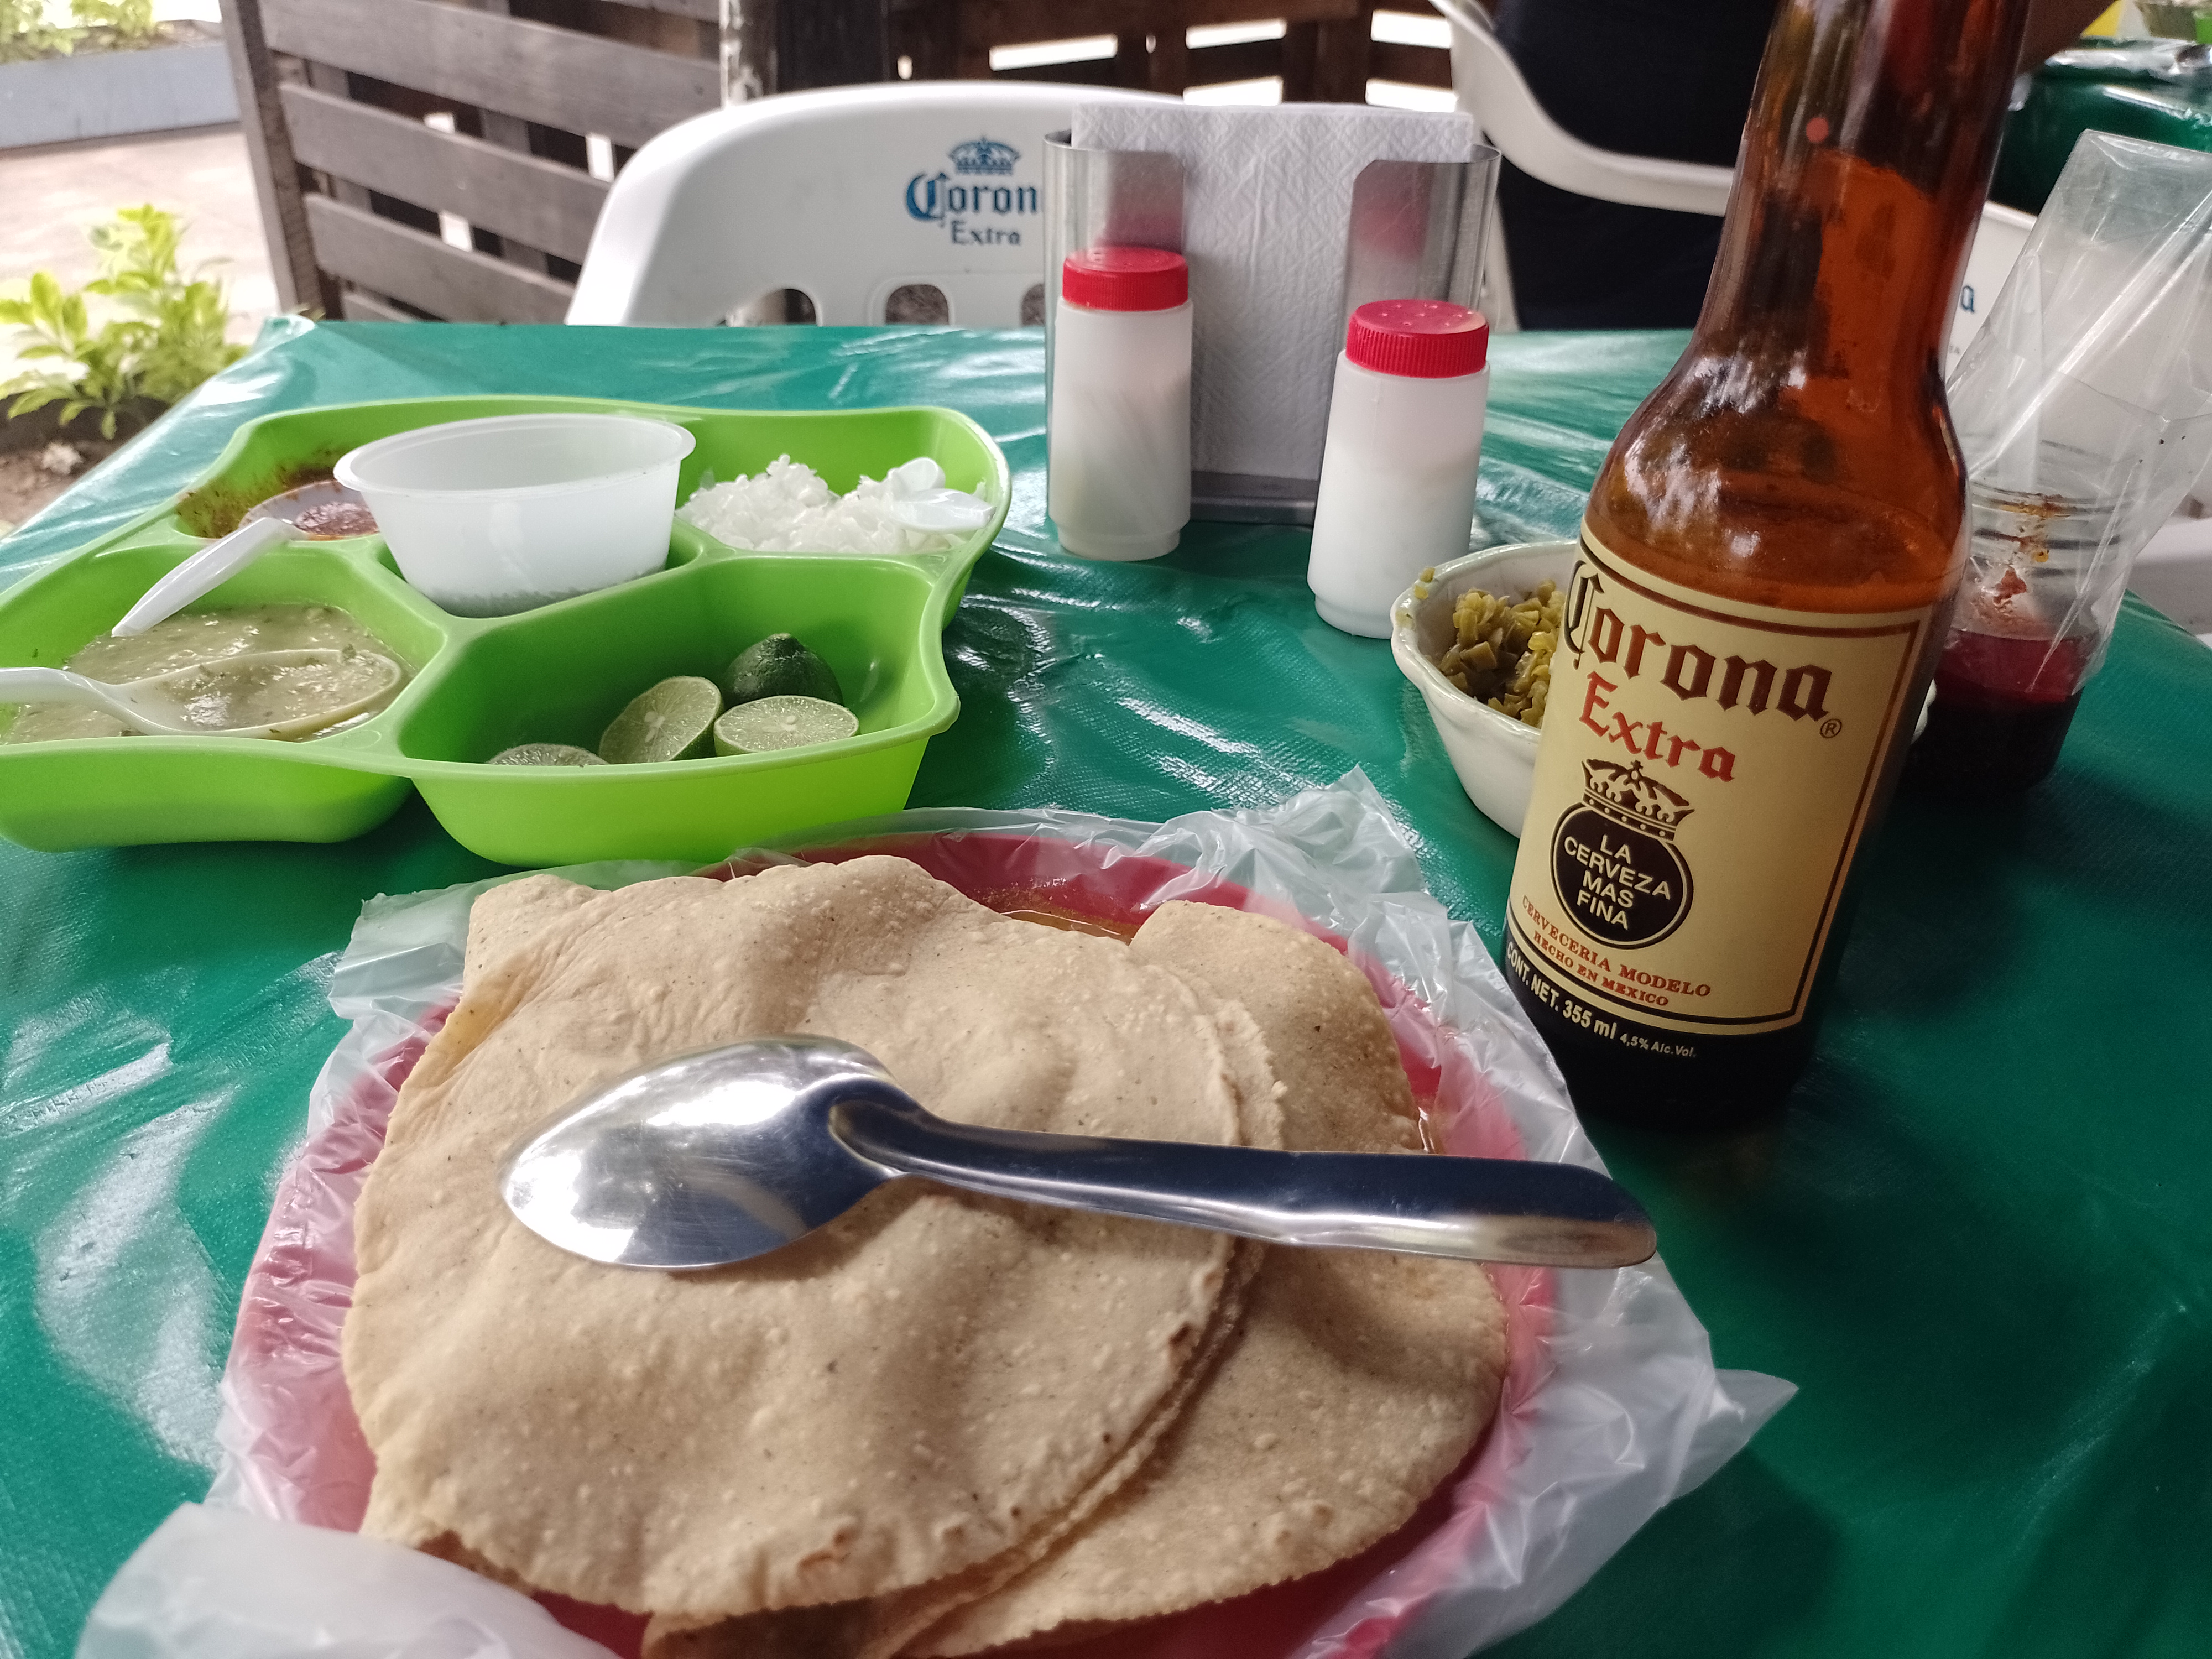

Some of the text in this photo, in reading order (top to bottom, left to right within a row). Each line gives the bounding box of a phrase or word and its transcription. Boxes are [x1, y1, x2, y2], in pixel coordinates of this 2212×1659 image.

[905, 171, 1040, 228] Coron
[950, 221, 1021, 245] Extra
[1563, 560, 1832, 722] Corona
[1579, 670, 1736, 782] Extra
[1564, 836, 1671, 900] CERVEZA
[1600, 834, 1631, 865] LA
[1577, 889, 1628, 930] FINA
[1582, 870, 1634, 908] MAS
[1522, 895, 1711, 997] CERVECERIA MODELO
[1533, 930, 1668, 1006] HECHO EN MEXICO
[1507, 941, 1530, 986] CONT.
[1531, 974, 1559, 1011] NET.
[1562, 1000, 1593, 1028] 355
[1593, 1019, 1617, 1039] ml
[1619, 1032, 1650, 1050] 4,5%
